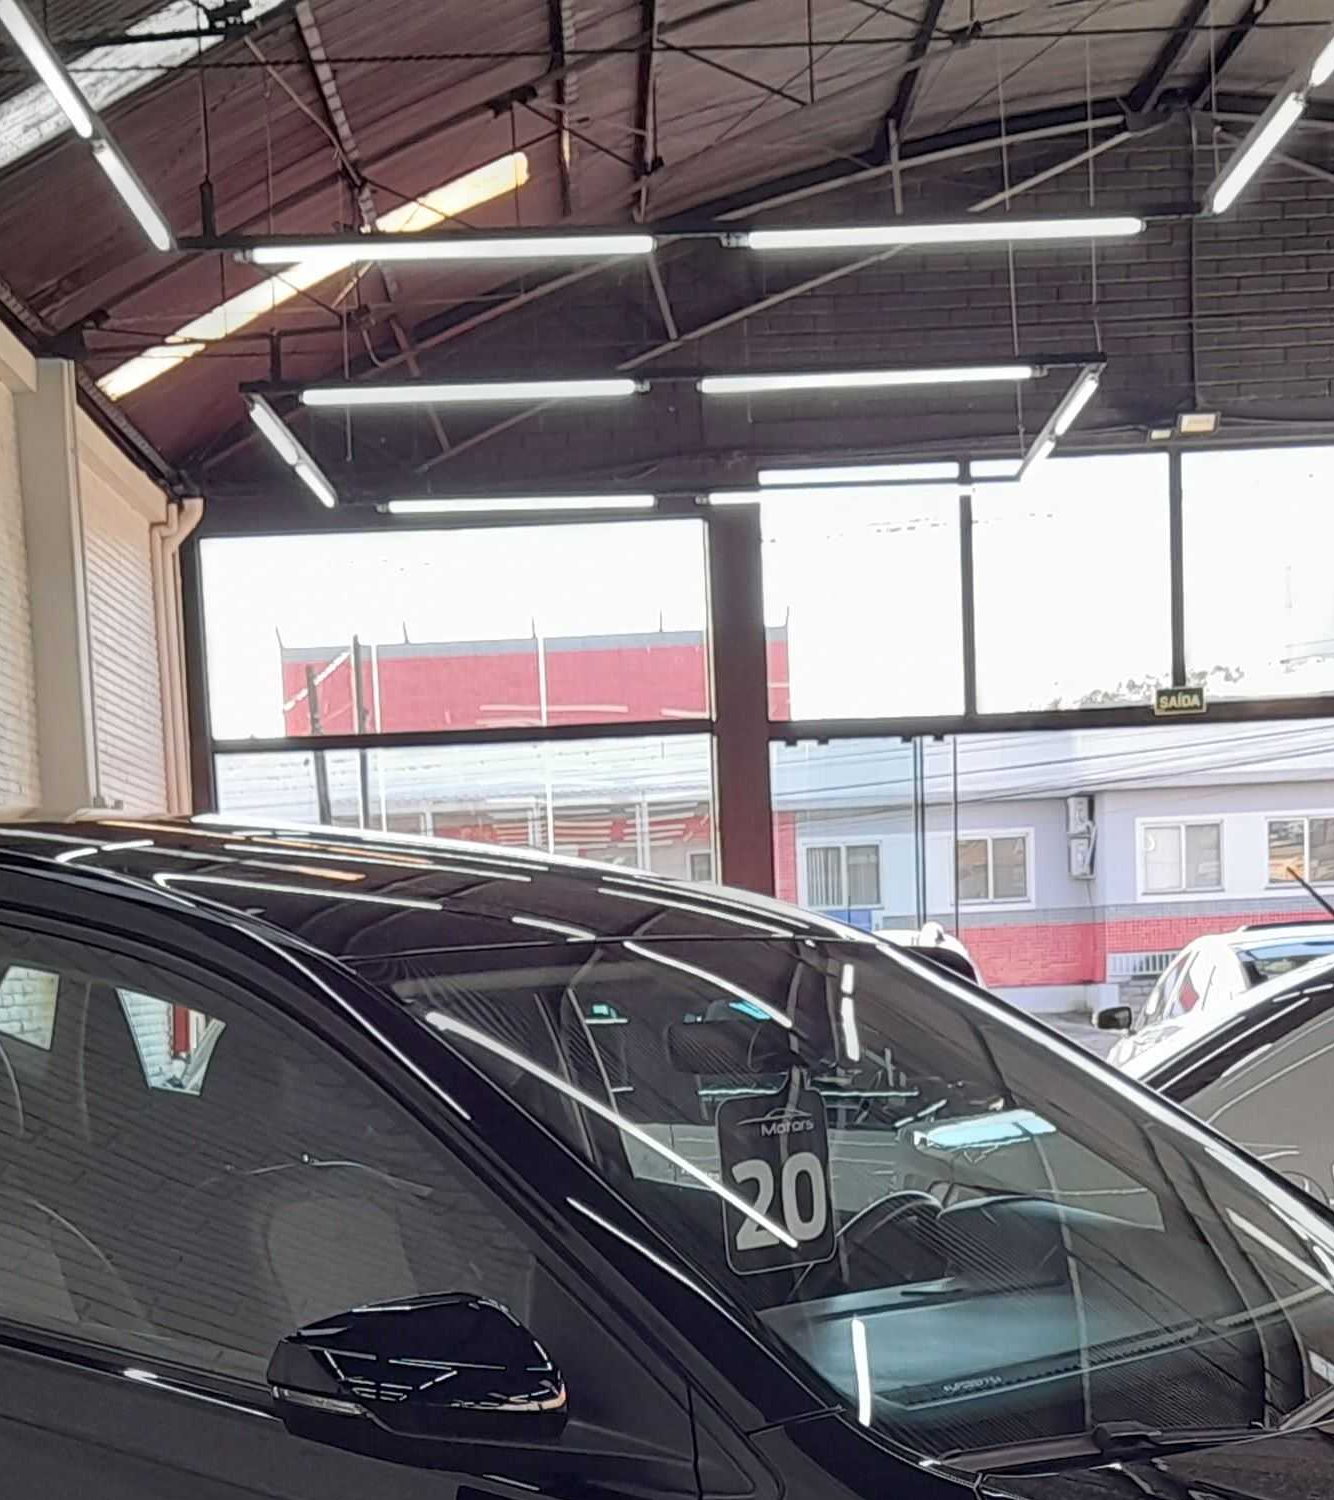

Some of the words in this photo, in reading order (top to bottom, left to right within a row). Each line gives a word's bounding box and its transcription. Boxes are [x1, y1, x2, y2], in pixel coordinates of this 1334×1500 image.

[1159, 691, 1201, 709] SAÍDA
[761, 1118, 815, 1137] Motors
[731, 1151, 827, 1251] 20
